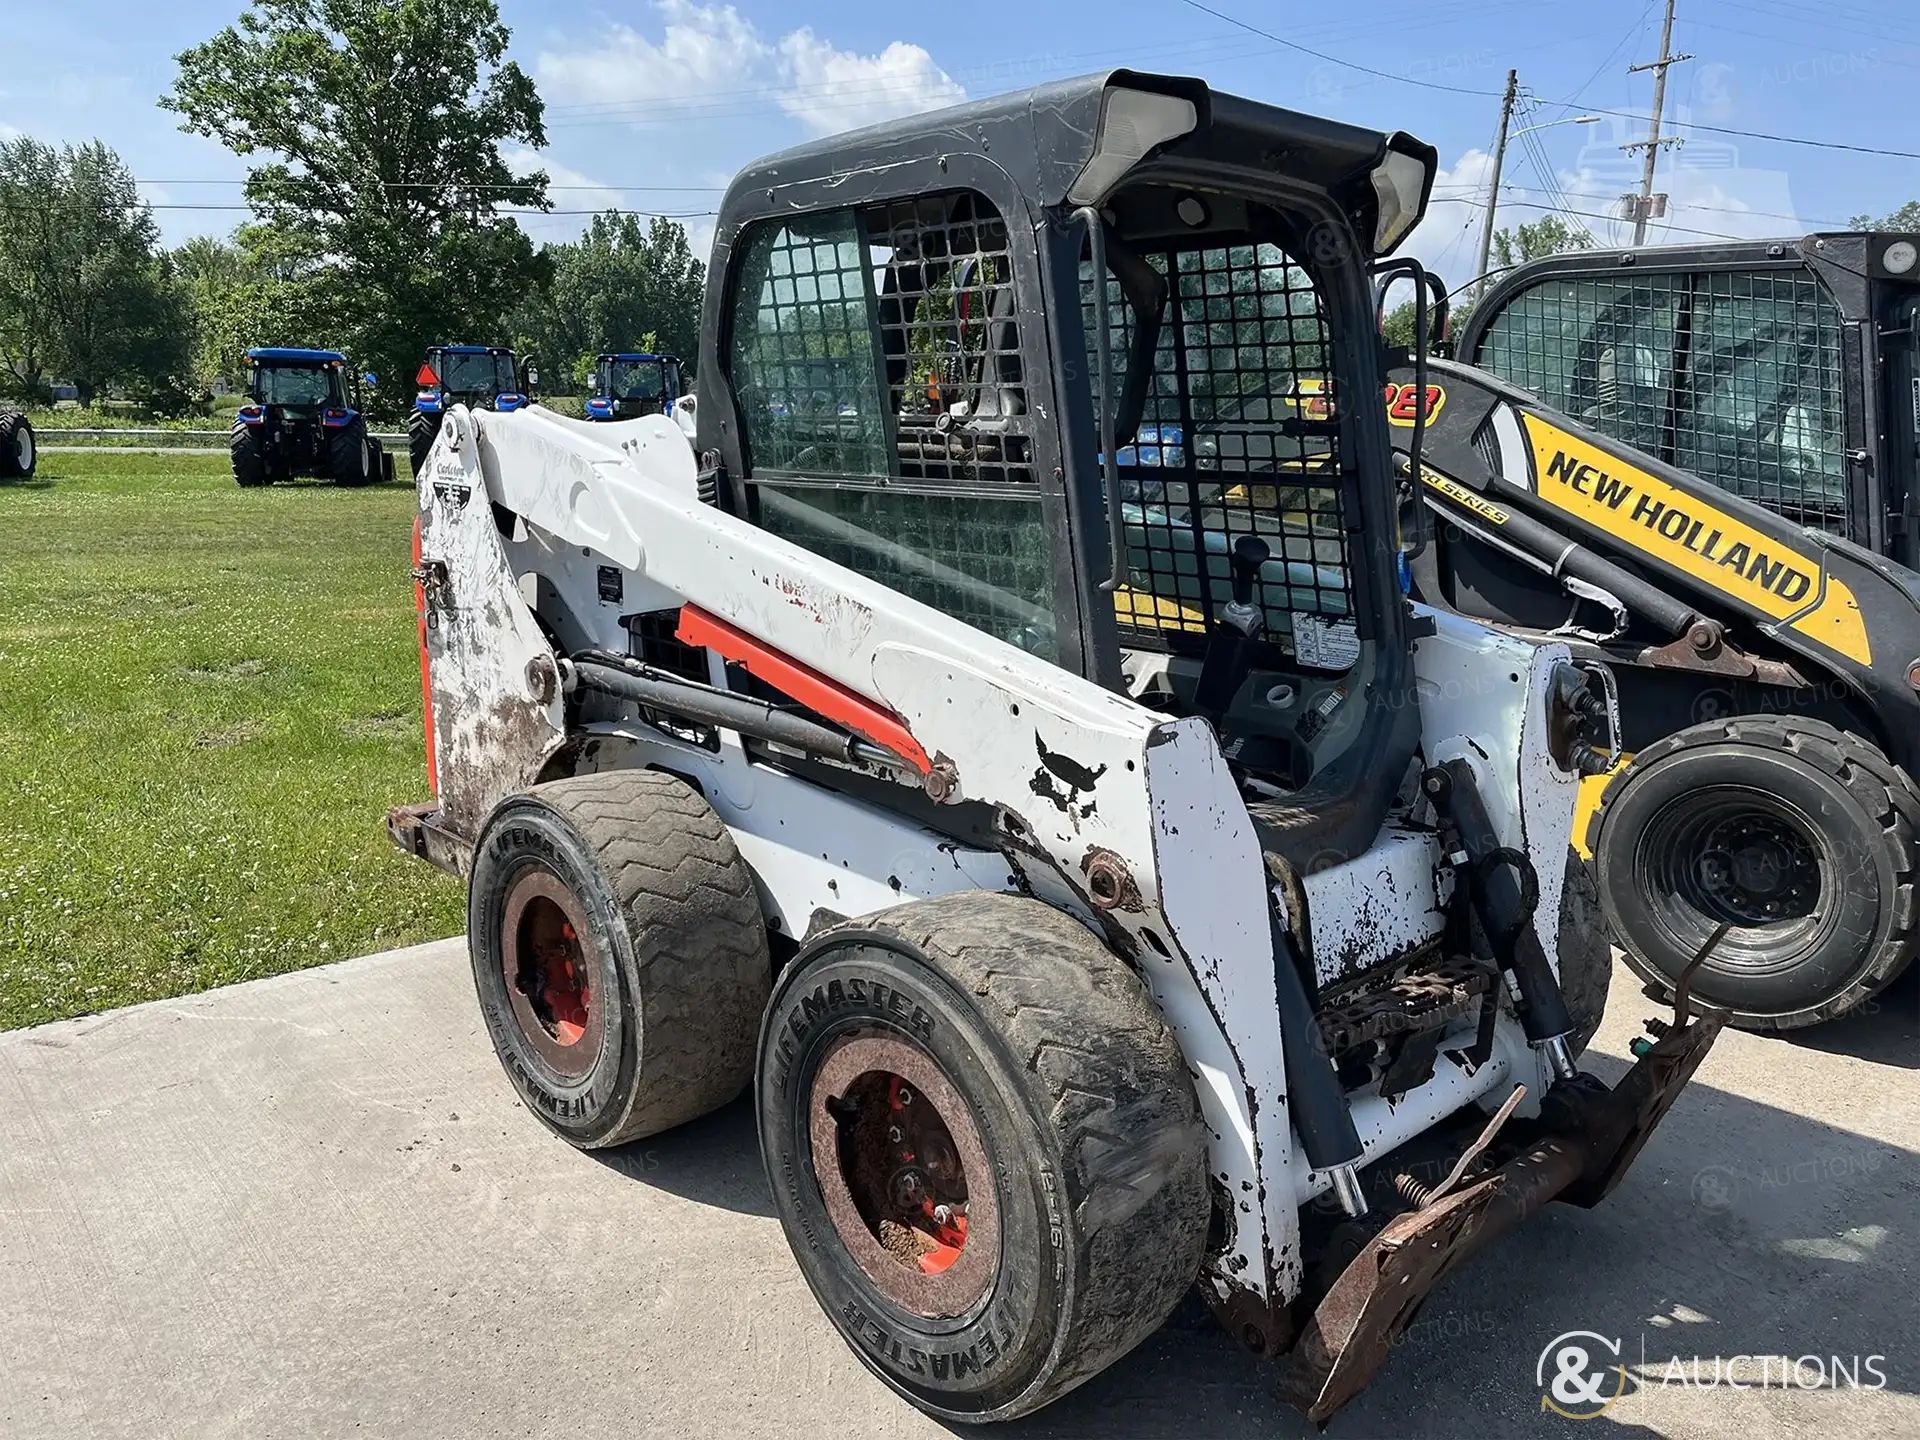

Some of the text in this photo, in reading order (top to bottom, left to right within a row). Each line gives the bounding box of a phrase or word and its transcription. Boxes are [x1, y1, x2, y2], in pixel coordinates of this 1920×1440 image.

[1441, 482, 1508, 522] SERIES
[1546, 450, 1811, 603] NEW HOLLAND
[771, 978, 936, 1098] LIFEMASTER
[843, 1270, 1022, 1381] LIFEMASTER
